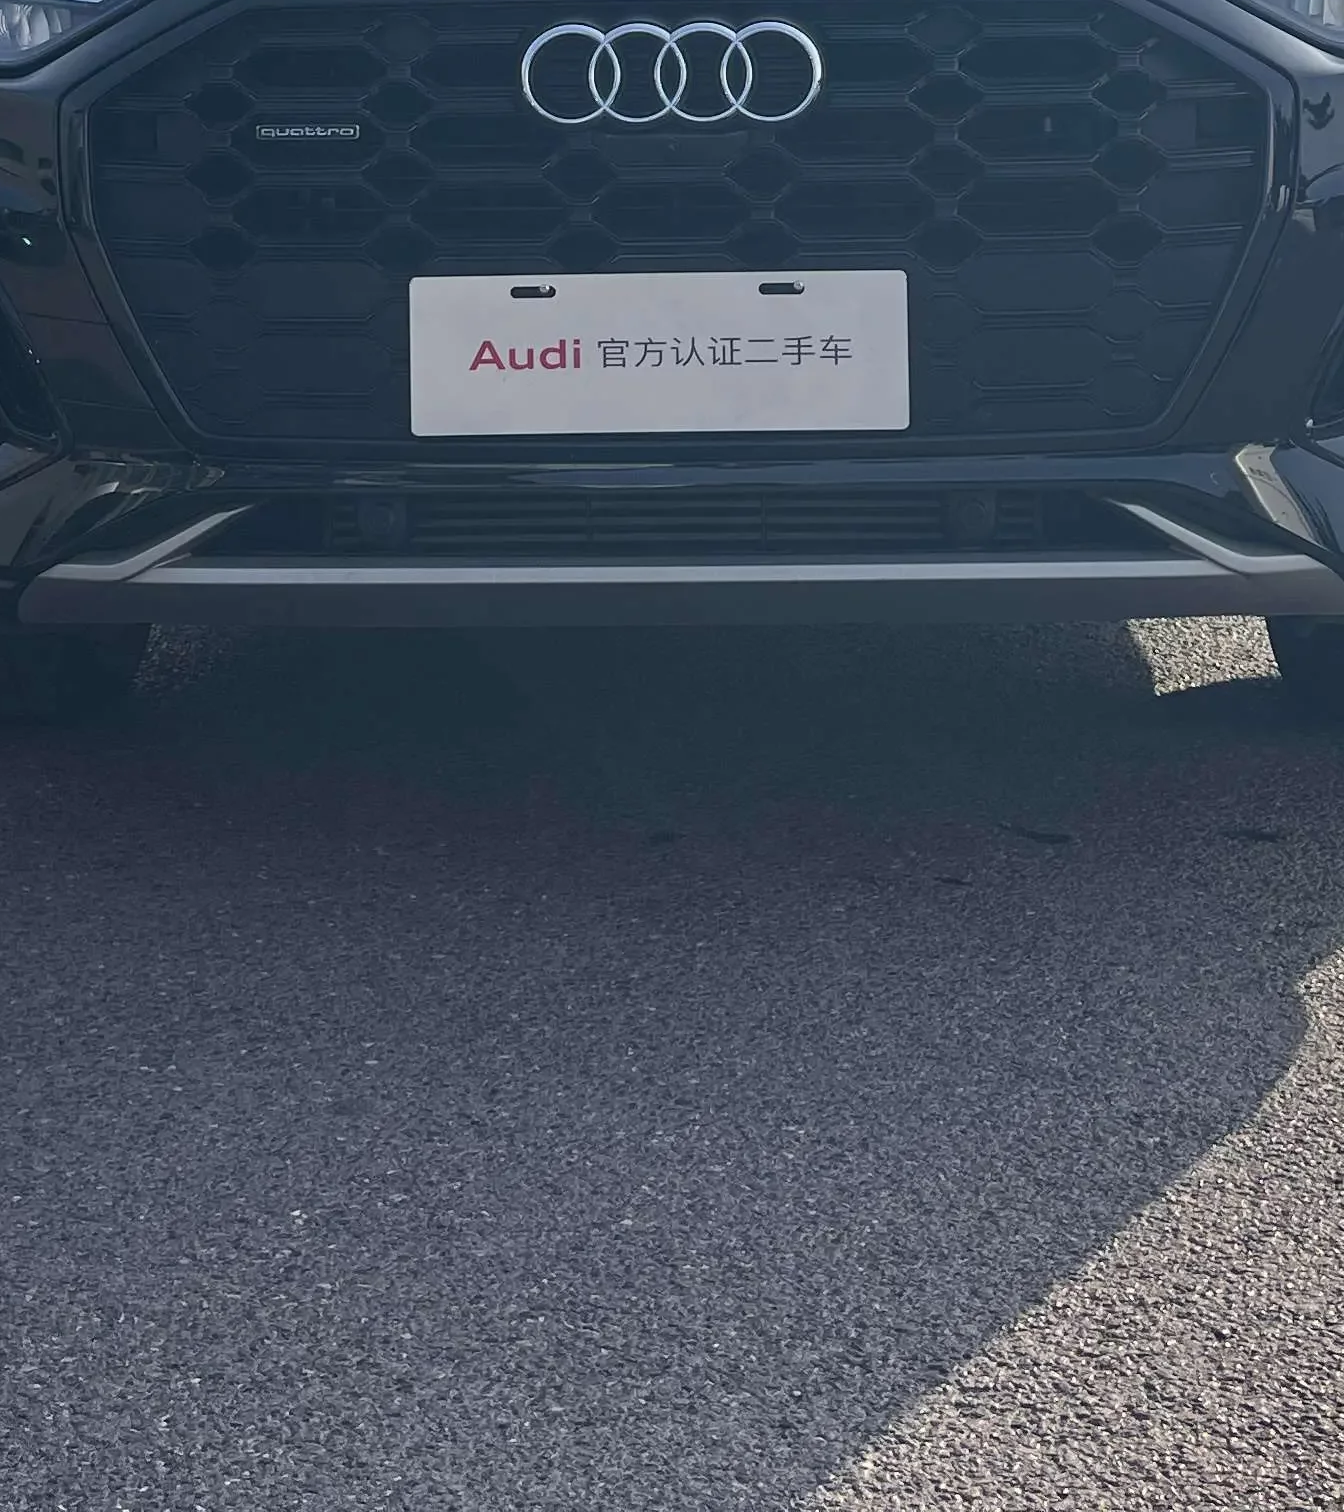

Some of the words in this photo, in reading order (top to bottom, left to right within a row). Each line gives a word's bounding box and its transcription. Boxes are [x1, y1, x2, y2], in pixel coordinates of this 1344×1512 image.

[260, 126, 354, 138] quattro
[469, 339, 581, 371] Audi
[597, 335, 853, 369] 官方认证二手车
